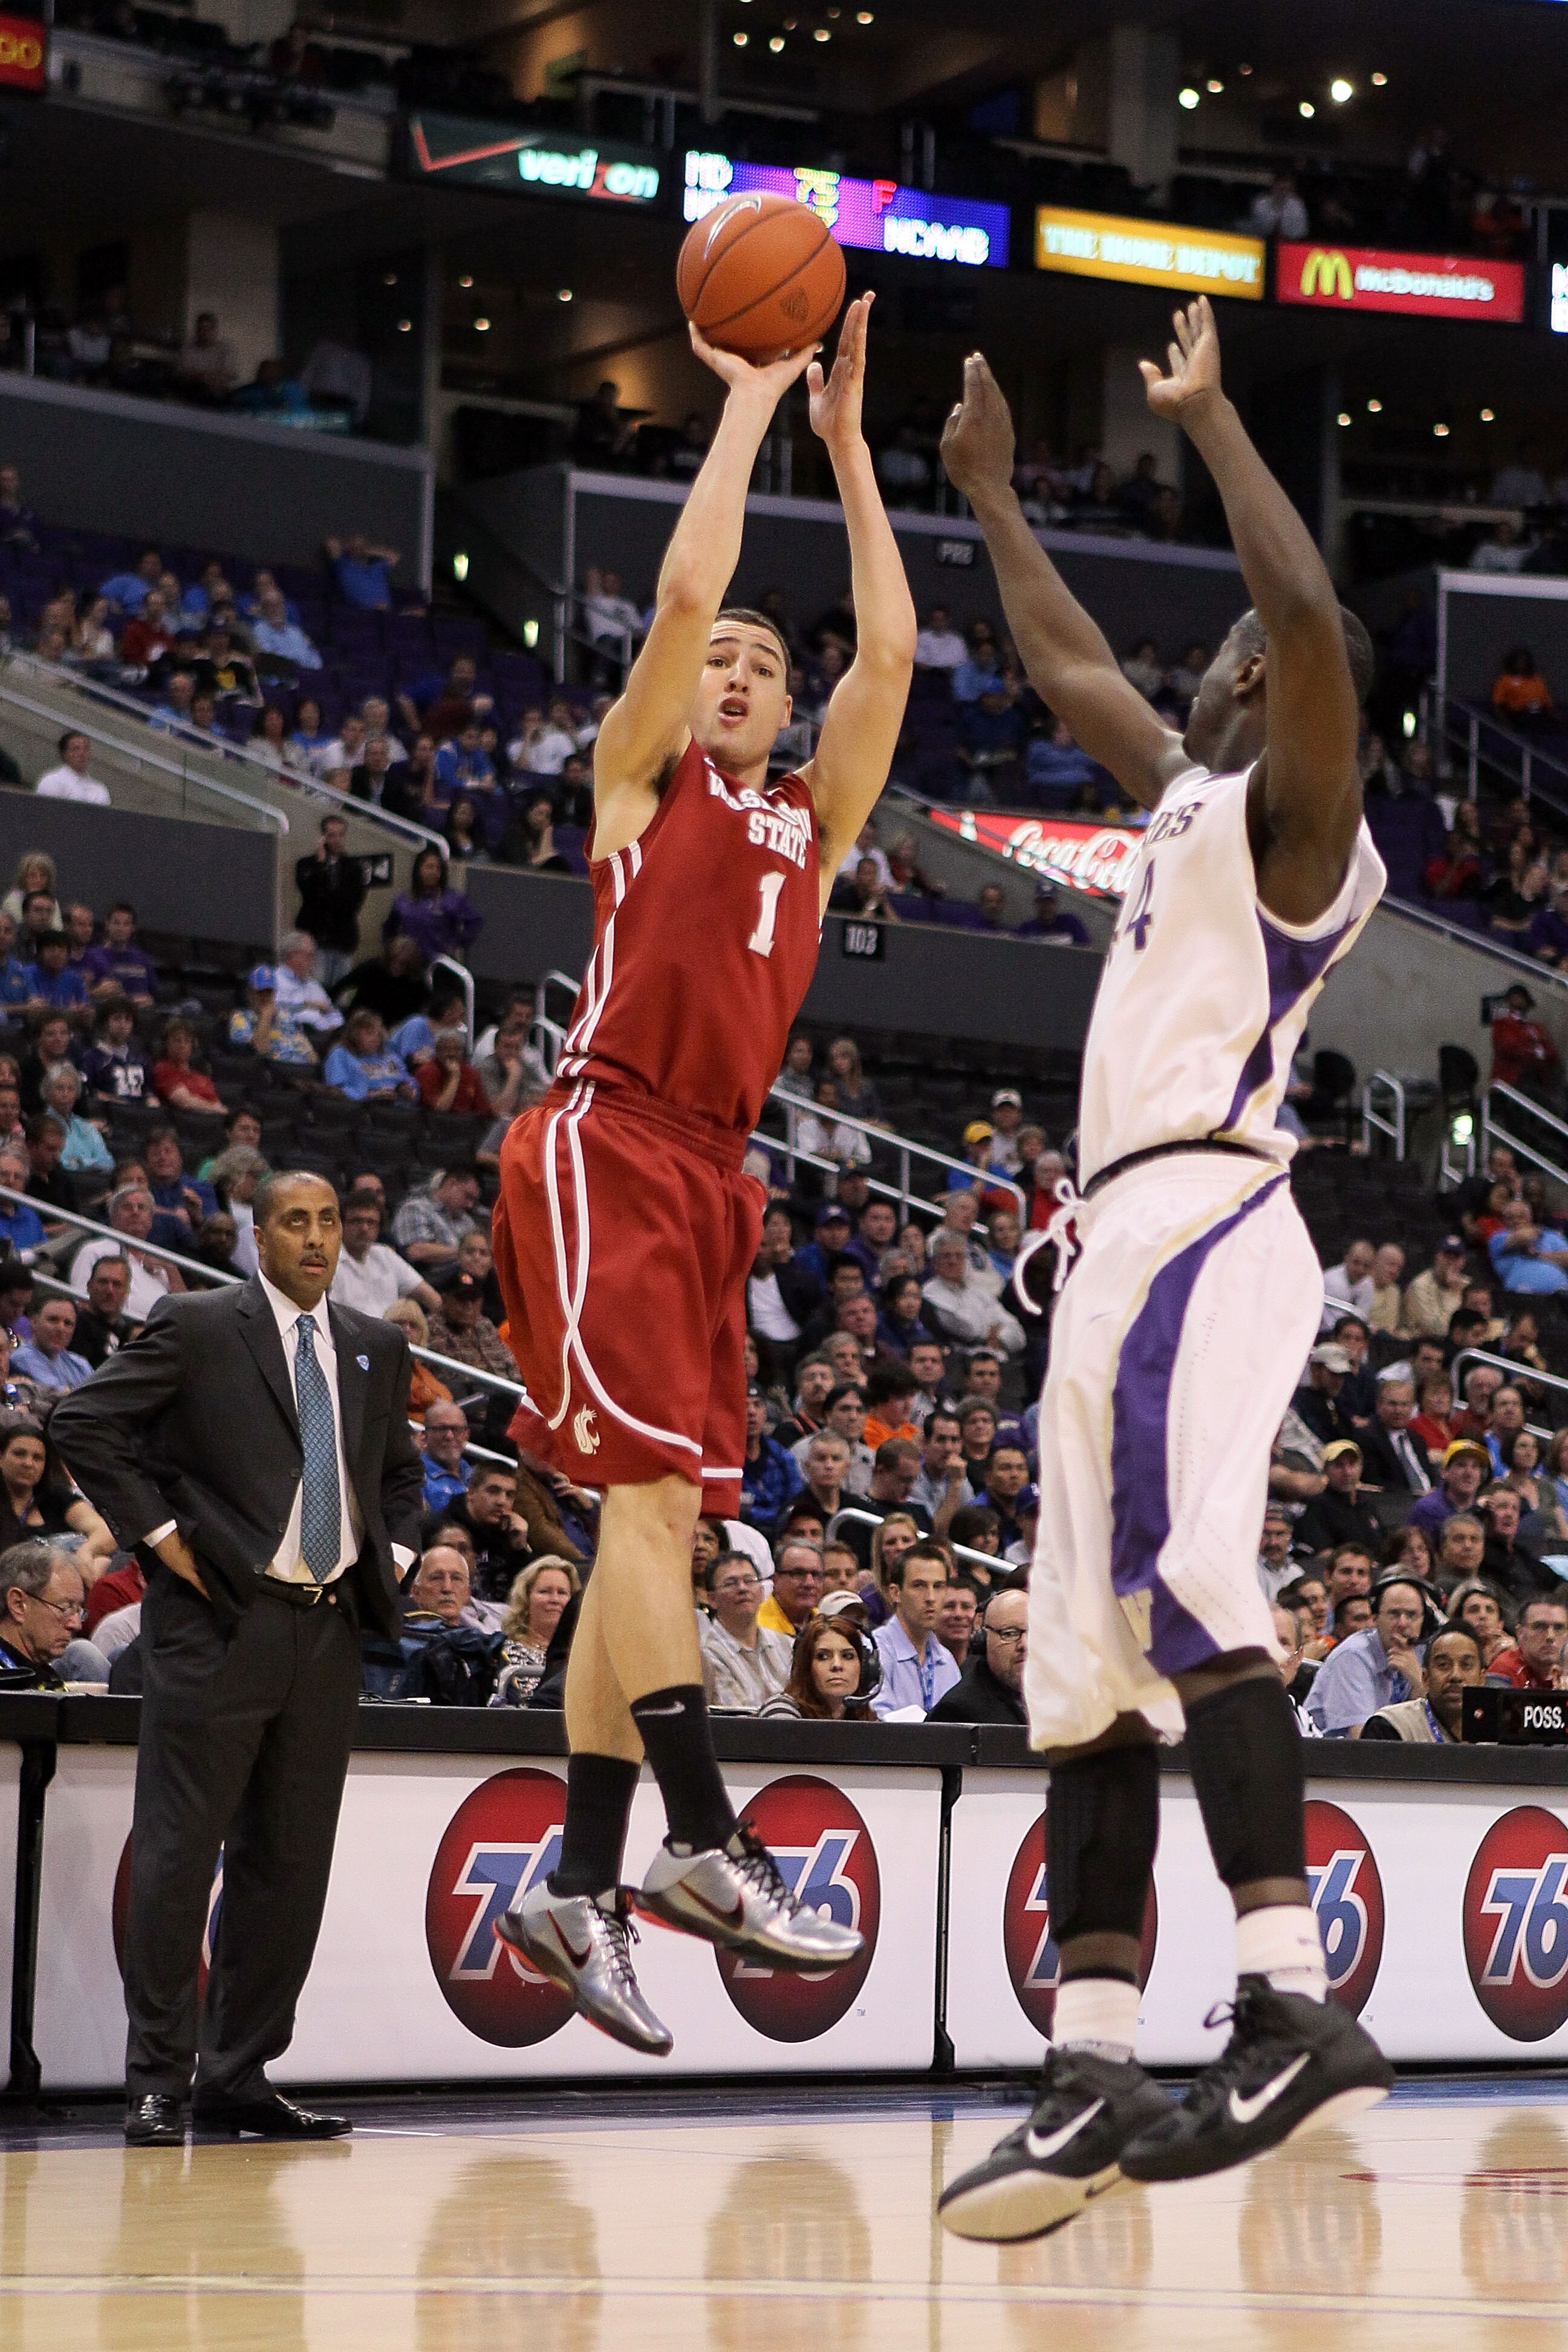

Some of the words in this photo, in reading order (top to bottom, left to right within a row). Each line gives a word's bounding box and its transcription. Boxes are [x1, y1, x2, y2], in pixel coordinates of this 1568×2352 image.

[518, 149, 660, 203] verizon
[1041, 222, 1099, 259] THE
[1100, 230, 1176, 271] HOME
[1176, 243, 1261, 283] DEPOT
[747, 810, 807, 870] STATE
[748, 870, 787, 958] 1
[1524, 1705, 1565, 1729] POSS.
[1479, 1852, 1568, 1989] 76
